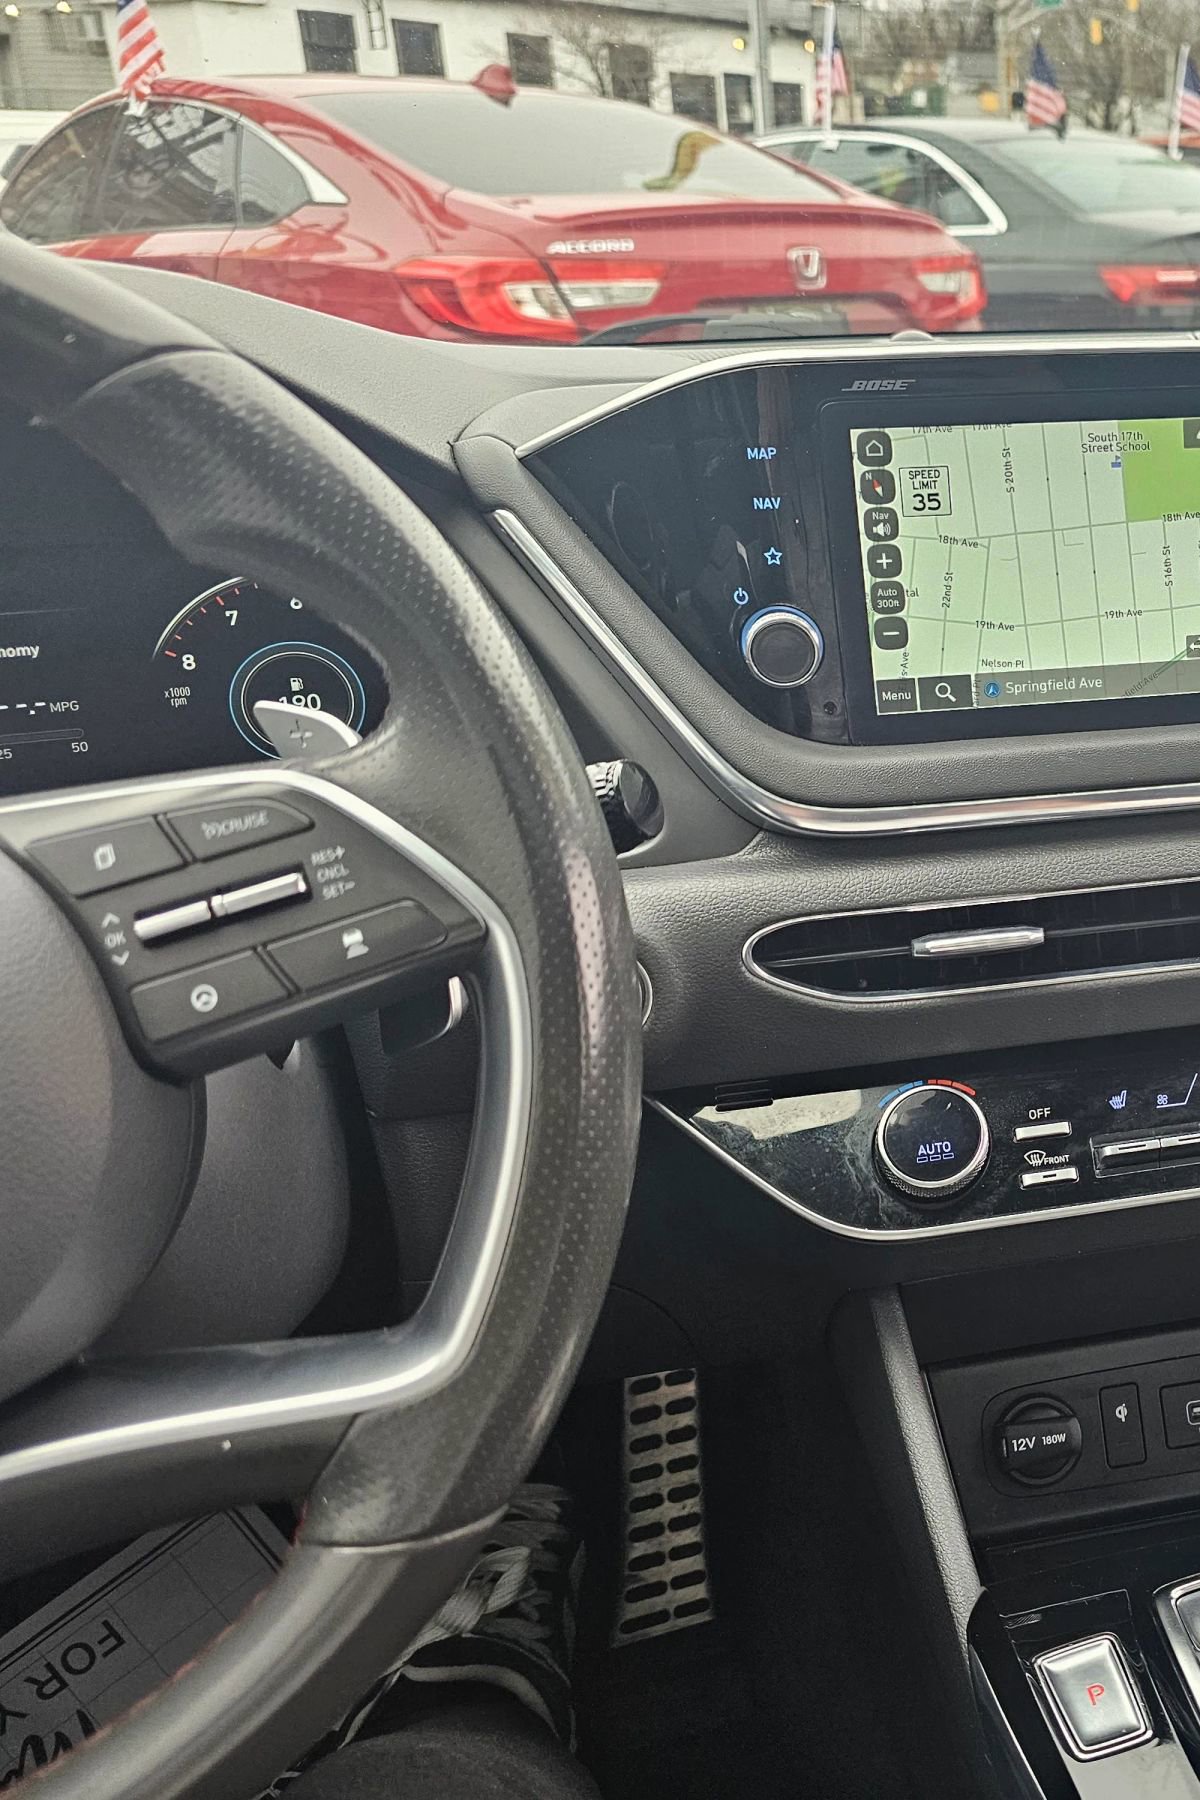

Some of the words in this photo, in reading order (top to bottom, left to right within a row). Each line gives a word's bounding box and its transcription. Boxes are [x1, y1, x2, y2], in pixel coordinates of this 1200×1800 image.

[841, 379, 917, 392] BOSE
[1087, 432, 1118, 442] South
[1120, 431, 1144, 441] 17th
[747, 447, 777, 460] MAP
[1002, 447, 1012, 458] St
[1081, 443, 1114, 454] Street
[1115, 441, 1151, 452] School
[865, 472, 872, 480] N
[908, 469, 941, 480] SPEED
[1003, 460, 1015, 485] 20th
[912, 480, 938, 490] LIMIT
[1006, 486, 1015, 494] S
[753, 497, 781, 510] NAV
[912, 492, 942, 512] 35
[872, 511, 889, 520] Nav
[1162, 513, 1182, 523] 18th
[1184, 511, 1200, 521] Ave
[938, 535, 960, 545] 18th
[960, 537, 980, 549] Ave
[1162, 545, 1171, 555] St
[1163, 556, 1172, 578] 16th
[944, 572, 954, 582] St
[1164, 578, 1173, 587] S
[877, 588, 898, 597] Auto
[942, 584, 952, 609] 22nd
[290, 597, 303, 610] 6
[877, 599, 900, 608] 300ft
[224, 610, 238, 626] 7
[1104, 610, 1124, 619] 19th
[1126, 608, 1143, 618] Ave
[975, 620, 996, 630] 19th
[997, 622, 1015, 632] Ave
[182, 653, 196, 671] 8
[901, 652, 910, 671] Ave
[981, 659, 1012, 669] Nelson
[1014, 660, 1025, 669] Pl
[164, 686, 191, 698] x1000
[1005, 678, 1077, 696] Springfield
[1079, 676, 1103, 690] Ave
[882, 690, 912, 701] Menu
[49, 700, 80, 713] MPG
[171, 698, 188, 709] rpm
[71, 741, 89, 753] 50
[221, 810, 269, 836] CRUISE
[104, 931, 127, 949] OK
[1028, 1107, 1052, 1120] OFF
[917, 1141, 952, 1156] AUTO
[1043, 1154, 1070, 1166] FRONT
[1011, 1435, 1036, 1453] 12V
[1041, 1432, 1067, 1447] 180W
[23, 1619, 127, 1700] FOR
[1085, 1683, 1106, 1706] P
